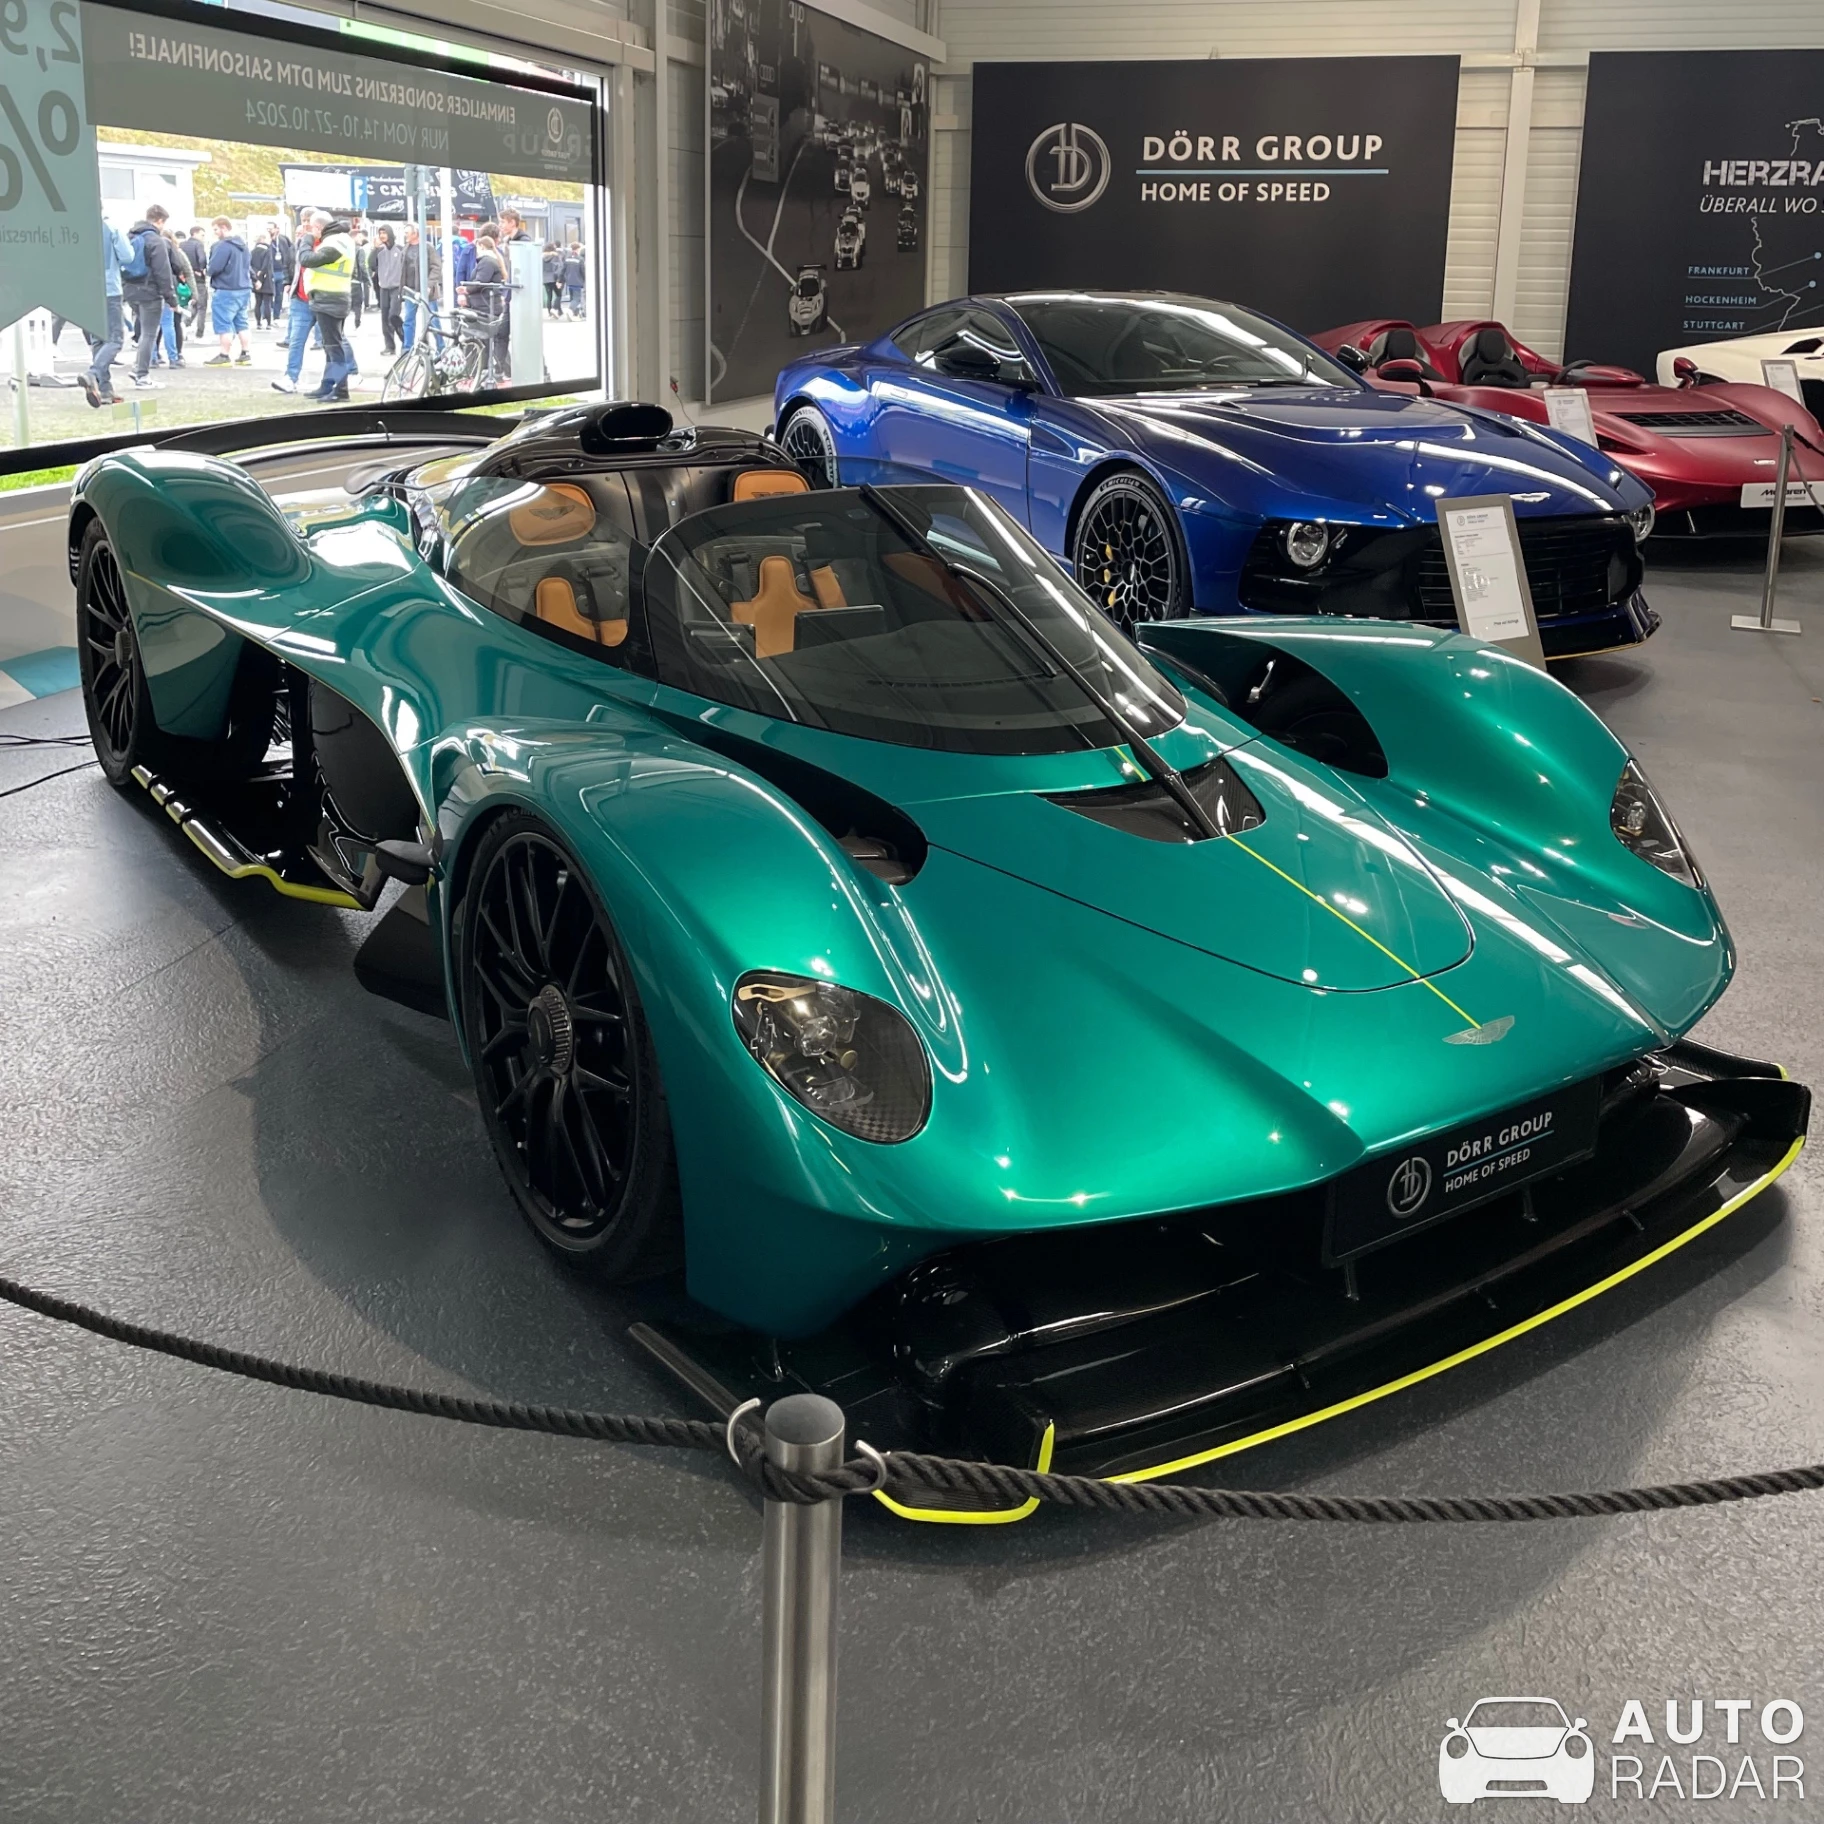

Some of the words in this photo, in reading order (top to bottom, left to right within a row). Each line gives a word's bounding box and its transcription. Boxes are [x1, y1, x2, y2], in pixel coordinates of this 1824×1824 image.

[1143, 130, 1241, 161] DÖRR
[1255, 134, 1383, 161] GROUP
[1141, 182, 1212, 202] HOME
[1217, 182, 1250, 202] OF
[1256, 182, 1331, 202] SPEED
[1700, 194, 1778, 213] ÜBERALL
[1785, 197, 1818, 213] WO
[1688, 266, 1750, 275] FRANKFURT
[1685, 295, 1757, 305] HOCKENHEIM
[1683, 320, 1746, 330] STUTTGART
[1447, 1136, 1492, 1168] DÖRR
[1499, 1112, 1553, 1146] GROUP
[1445, 1169, 1479, 1193] HOME
[1481, 1162, 1496, 1178] OF
[1498, 1148, 1531, 1171] SPEED
